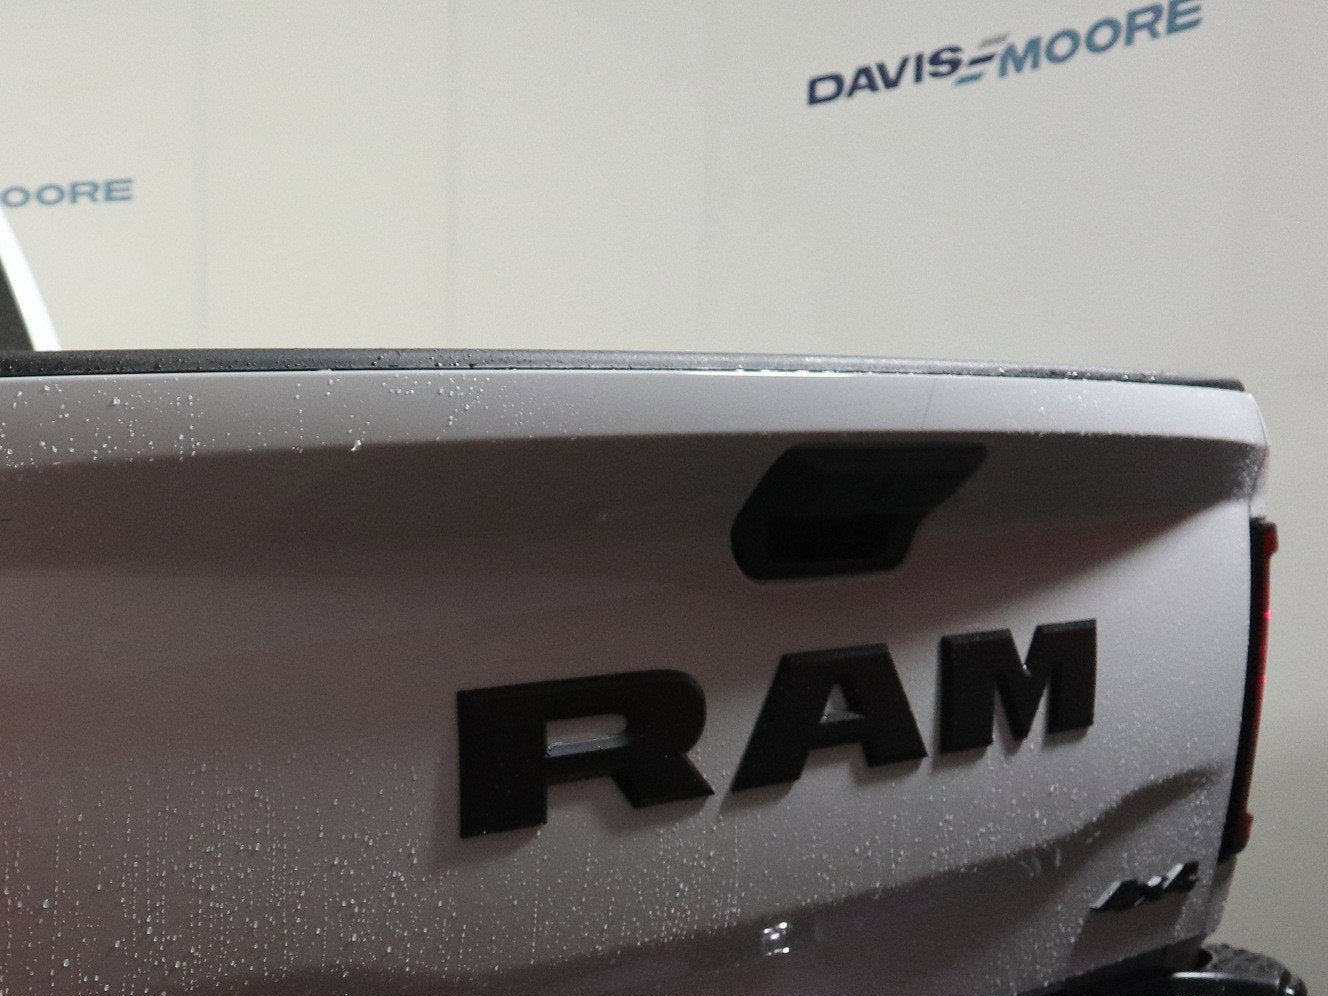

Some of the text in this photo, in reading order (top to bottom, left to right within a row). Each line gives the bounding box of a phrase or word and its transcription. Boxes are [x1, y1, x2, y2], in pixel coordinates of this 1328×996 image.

[807, 0, 1203, 105] DAVIS MOORE
[456, 618, 1097, 839] RAM
